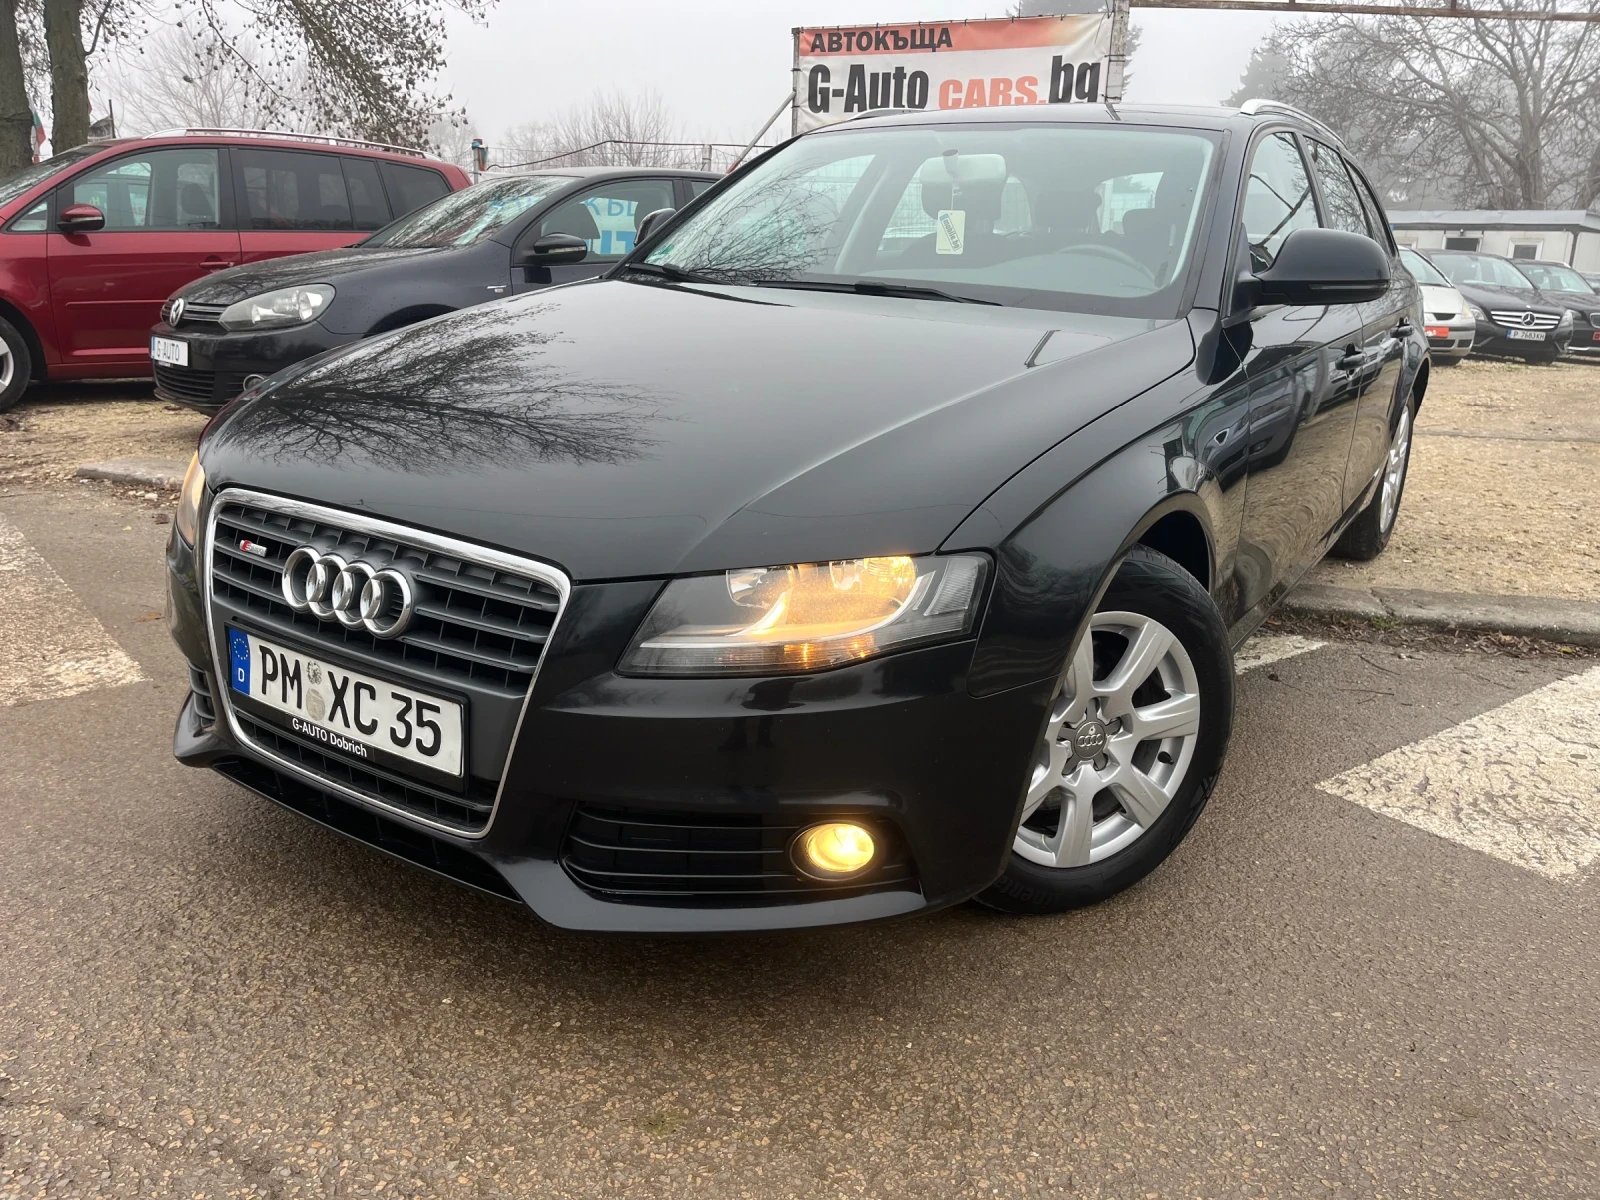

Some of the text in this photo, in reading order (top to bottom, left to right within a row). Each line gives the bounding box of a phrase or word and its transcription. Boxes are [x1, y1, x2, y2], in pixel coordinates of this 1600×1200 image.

[810, 28, 953, 52] АВТОКЪЩА
[808, 64, 929, 113] G-Auto
[259, 645, 303, 709] PM
[390, 691, 442, 757] 35
[292, 718, 368, 758] G-AUTO Dobrich
